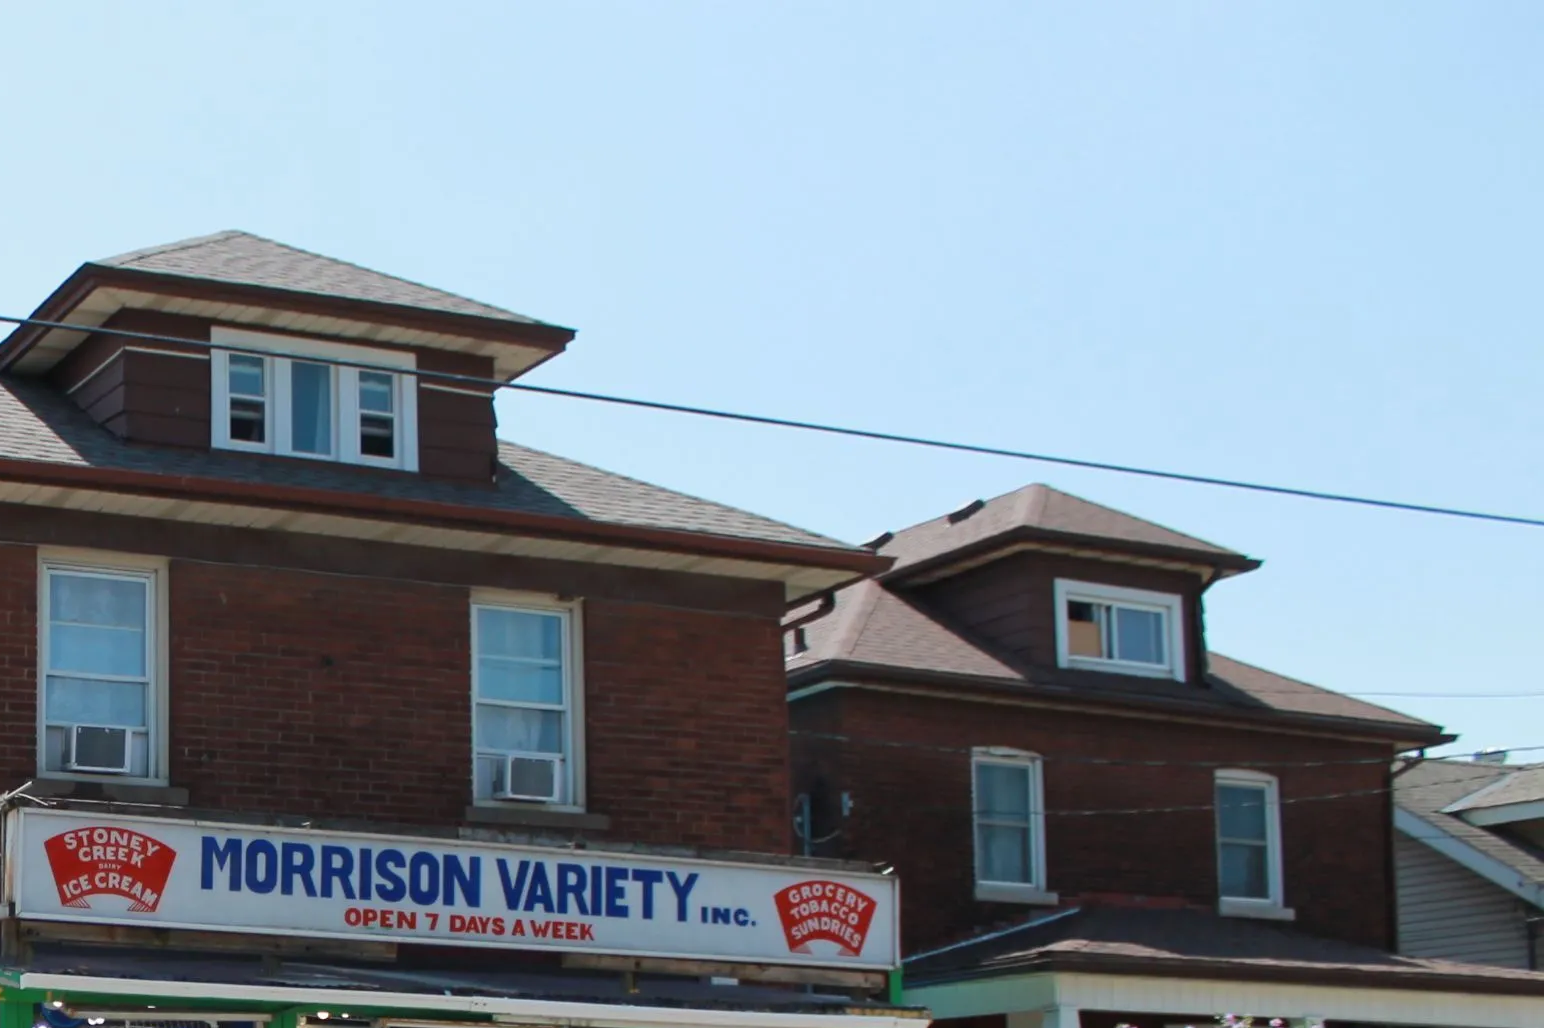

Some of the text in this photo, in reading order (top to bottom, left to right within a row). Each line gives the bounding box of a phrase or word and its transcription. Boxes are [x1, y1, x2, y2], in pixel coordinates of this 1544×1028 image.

[64, 828, 160, 857] STONEY
[78, 845, 145, 869] CREEK
[98, 863, 122, 871] DAIRY
[200, 835, 758, 927] MORRISON VARIETY INC.
[62, 872, 158, 907] ICE CREAM
[788, 883, 868, 912] GROCERY
[343, 907, 595, 942] OPEN 7 DAYS A WEEK
[789, 900, 859, 925] TOBACCO
[791, 917, 862, 948] SUNDRIES
